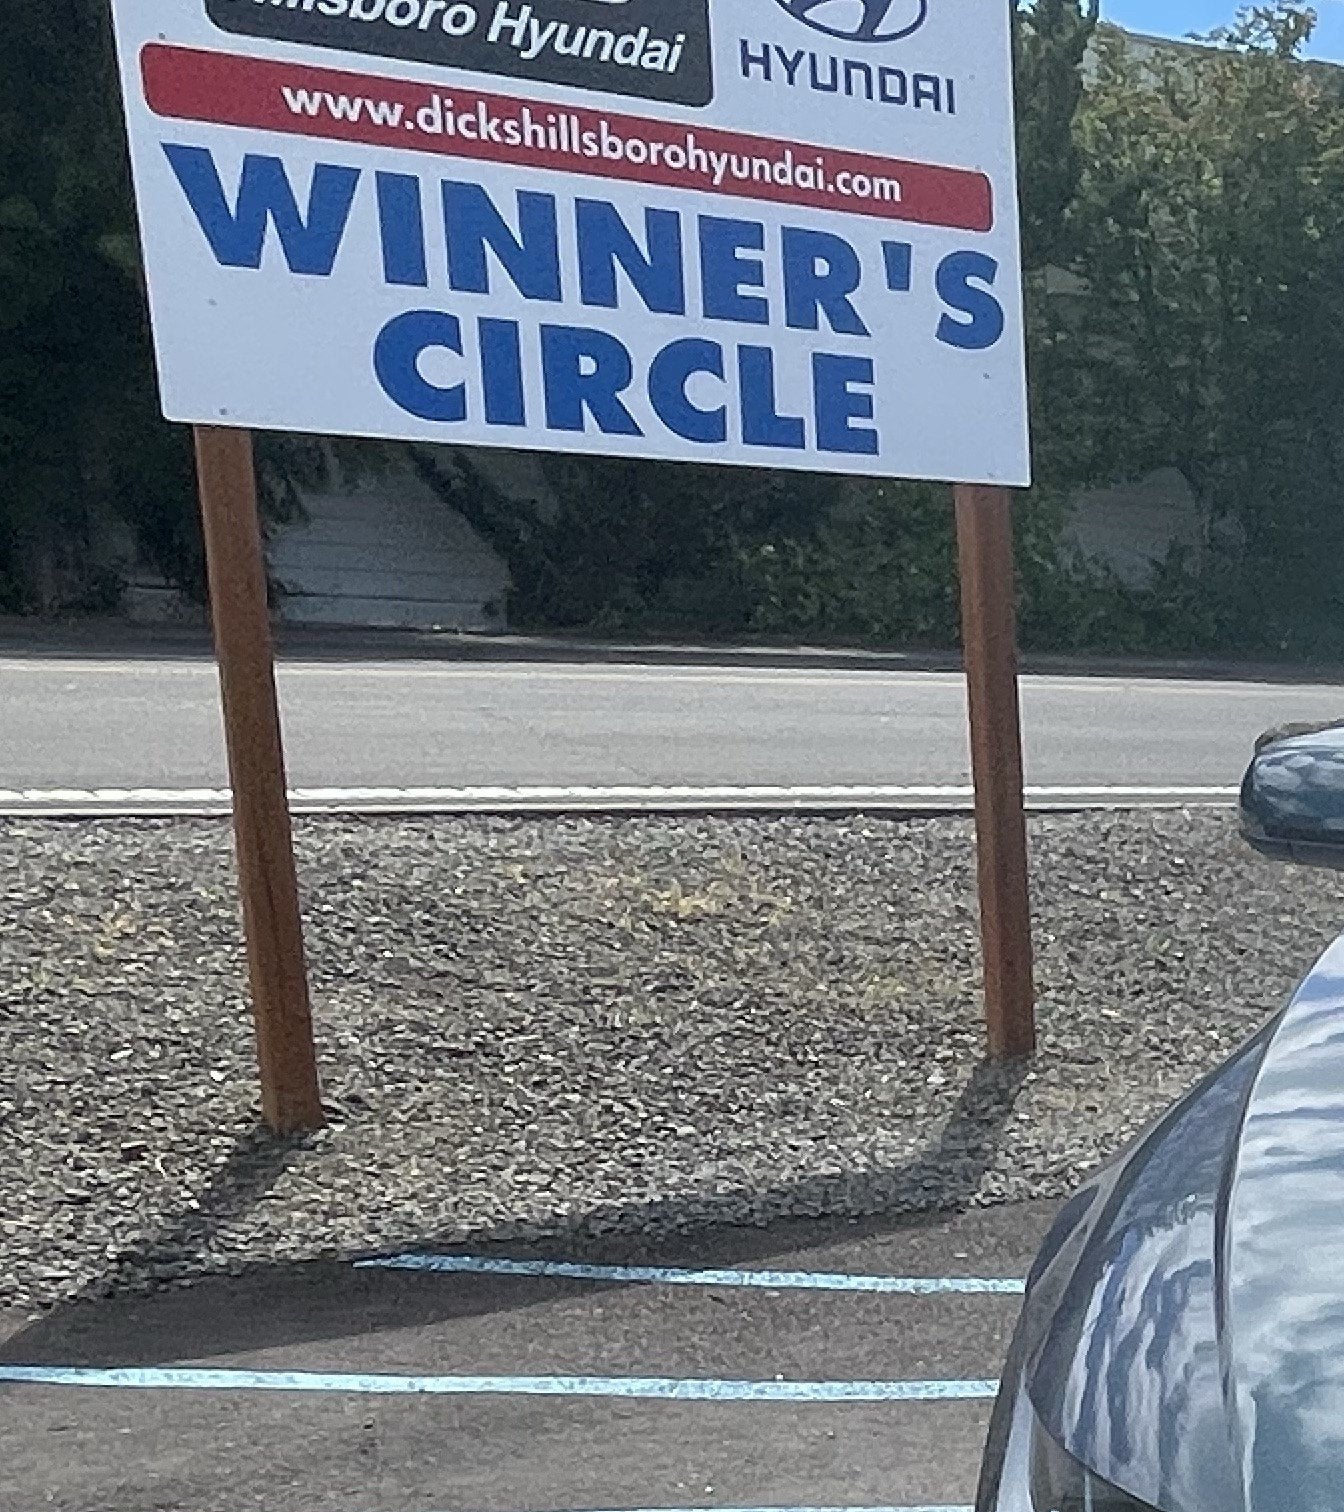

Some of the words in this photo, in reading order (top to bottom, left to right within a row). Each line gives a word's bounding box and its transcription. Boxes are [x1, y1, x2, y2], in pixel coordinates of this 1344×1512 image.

[486, 0, 686, 73] Hyundai
[740, 38, 955, 114] HYUNDAI
[281, 86, 902, 202] www.dickshillsborohyundai.com
[160, 142, 1004, 351] WINNER'S
[373, 310, 880, 456] CIRCLE
